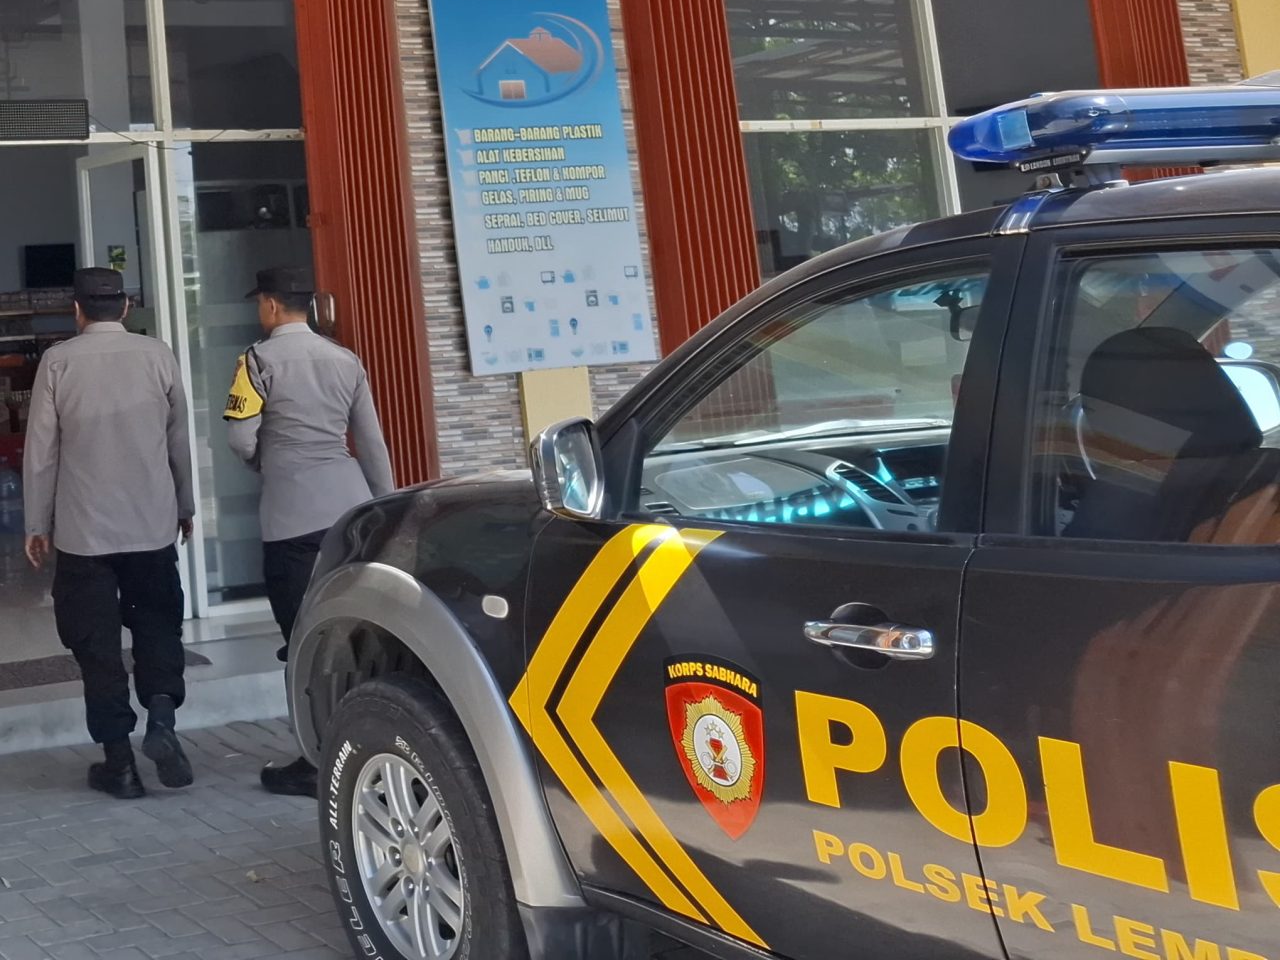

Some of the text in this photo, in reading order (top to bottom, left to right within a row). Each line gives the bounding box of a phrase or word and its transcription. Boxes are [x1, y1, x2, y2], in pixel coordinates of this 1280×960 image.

[474, 124, 602, 143] BARANG-BARANG PLASTIK
[477, 147, 565, 164] ALAT KEBERSIHAN
[563, 165, 606, 180] KOMPOR
[519, 189, 553, 203] PIRING
[565, 186, 589, 200] MUG
[526, 212, 546, 227] BED
[586, 208, 629, 223] SELIMUT
[535, 235, 554, 251] DLL
[668, 662, 758, 698] KORPS SABHARA
[794, 690, 1280, 911] POLI
[812, 829, 1056, 933] POLSEK
[329, 839, 384, 960] ELER
